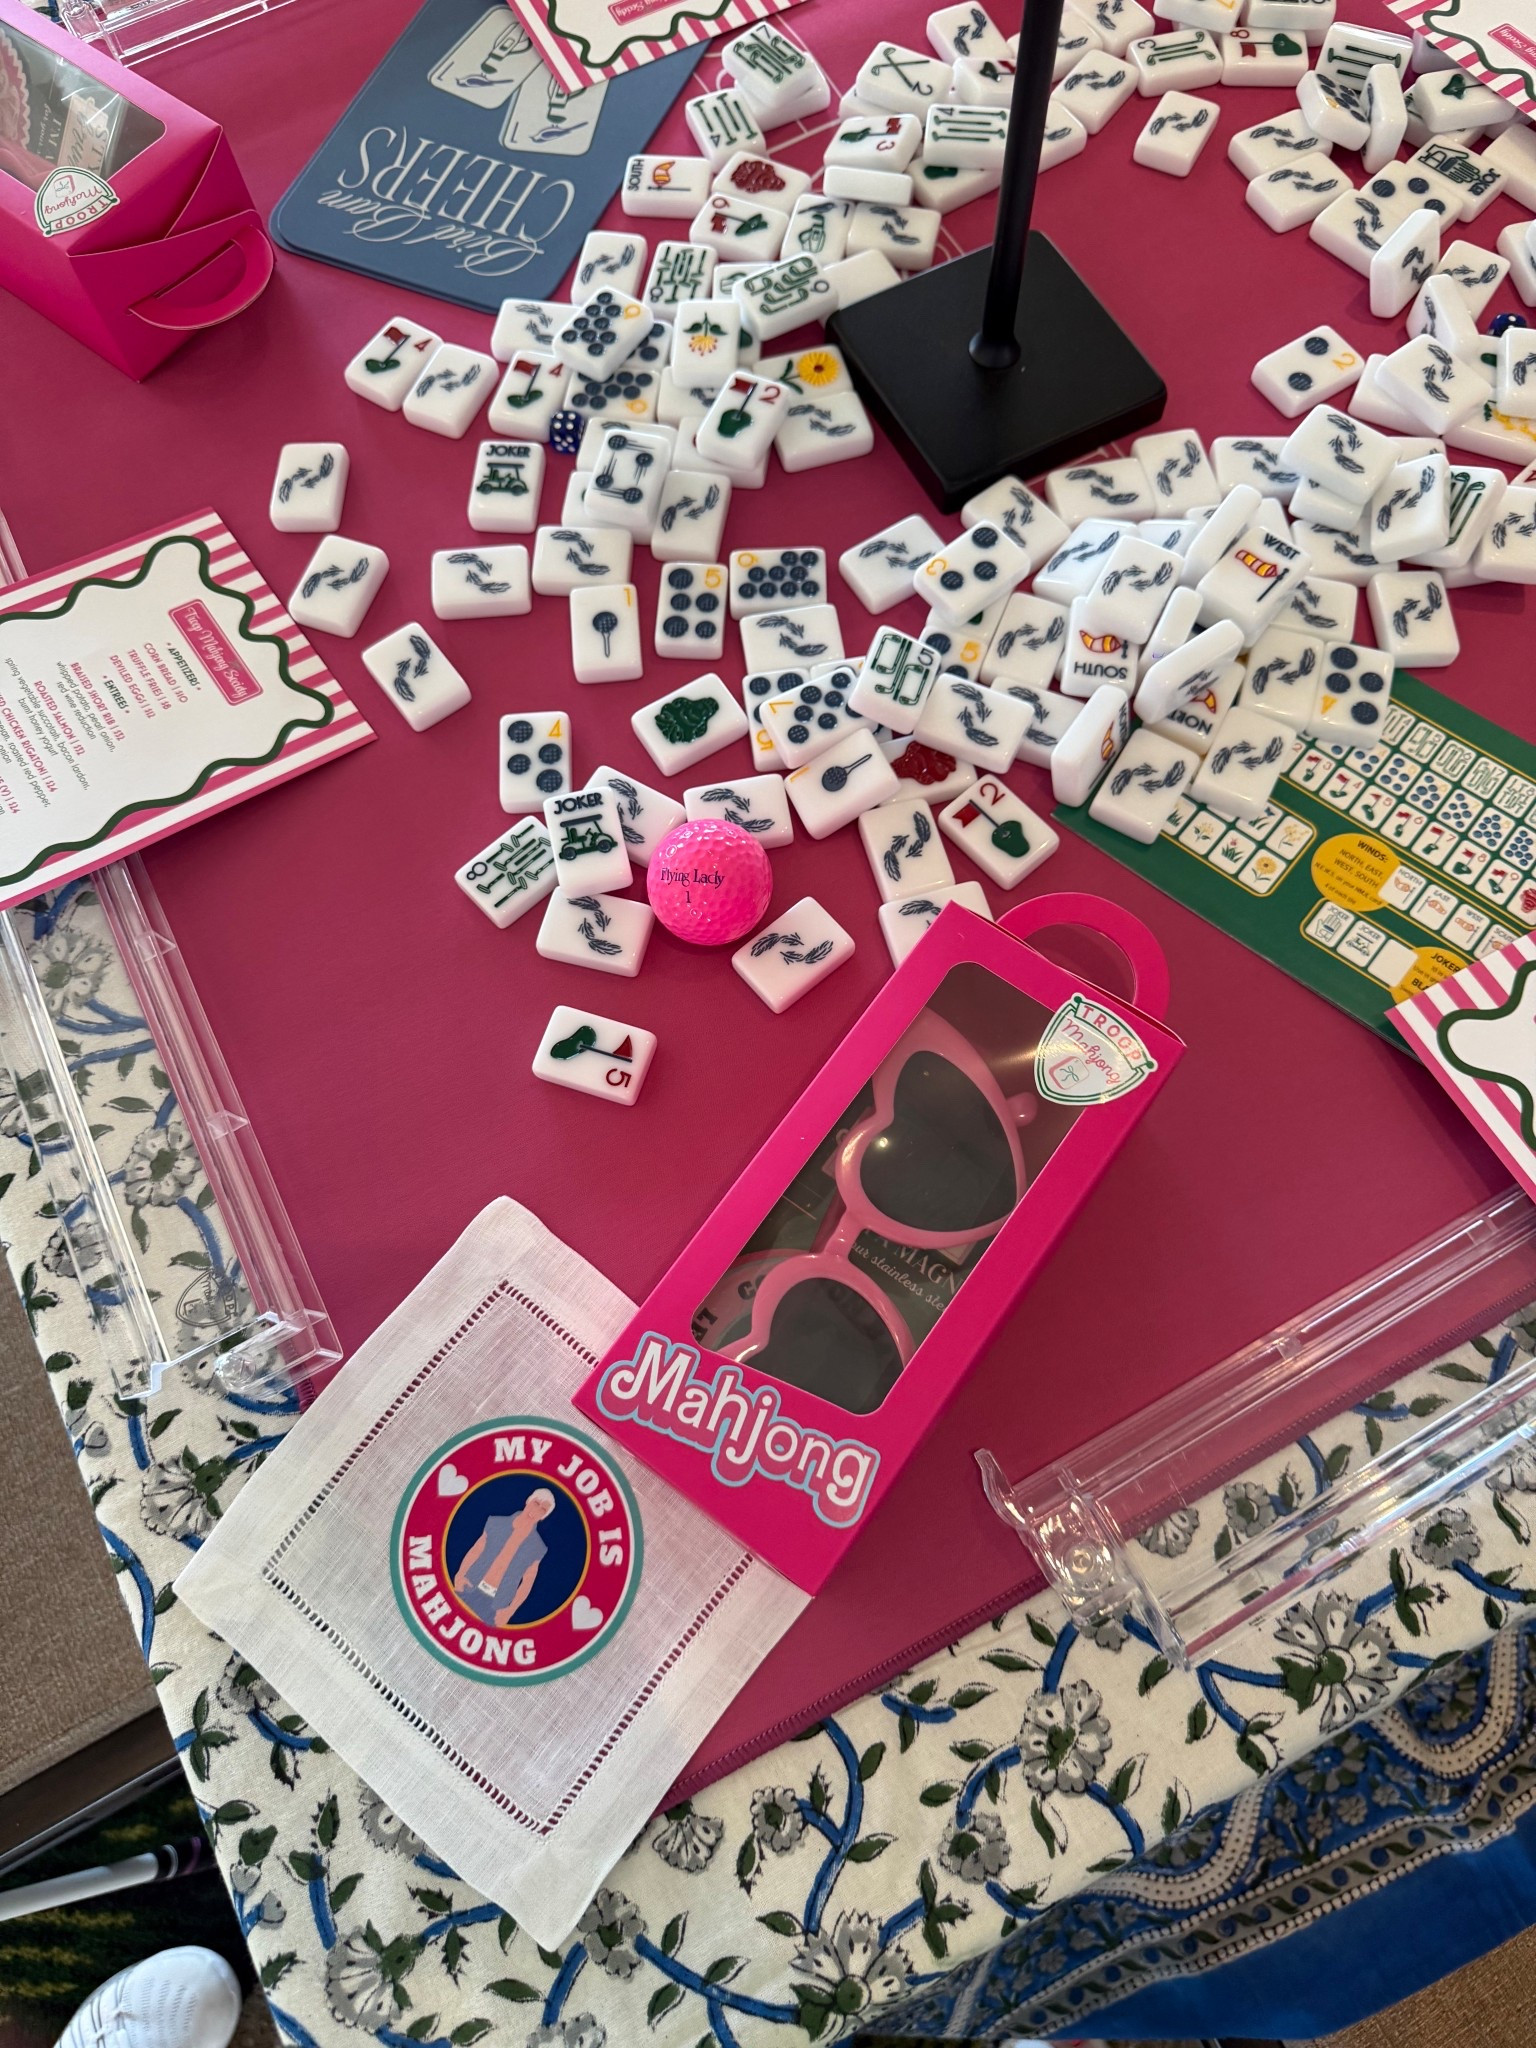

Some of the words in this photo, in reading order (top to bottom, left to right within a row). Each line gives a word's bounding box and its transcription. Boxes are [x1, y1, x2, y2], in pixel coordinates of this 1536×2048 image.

[755, 24, 771, 39] 7
[1230, 29, 1250, 38] 8
[1138, 39, 1156, 50] 3
[912, 82, 933, 96] 2
[937, 108, 955, 116] 4
[710, 134, 720, 148] 4
[876, 140, 896, 151] 3
[338, 126, 574, 241] CHEERS
[628, 159, 644, 192] SOUTH
[1468, 168, 1502, 196] JOKER
[43, 186, 103, 216] Mahjong
[55, 198, 108, 229] TROOP
[414, 338, 434, 352] 4
[549, 362, 565, 378] 4
[1332, 352, 1356, 371] 2
[760, 385, 781, 404] 2
[486, 444, 531, 458] JOKER
[1262, 532, 1300, 562] WEST
[704, 568, 722, 589] 5
[925, 558, 947, 576] 3
[200, 630, 228, 670] Mahjong
[917, 647, 936, 667] 5
[127, 649, 150, 677] TRUFFLE
[146, 677, 162, 696] FRIES
[143, 643, 162, 663] CORN
[157, 663, 176, 685] BREAD
[175, 690, 188, 702] $10
[168, 648, 199, 685] APPETIZERS
[1074, 661, 1128, 680] SOUTH
[109, 655, 132, 682] DEVILED
[128, 683, 146, 703] EGGS
[56, 661, 78, 688] whipped
[86, 712, 105, 730] pearl
[70, 662, 92, 689] BRAISED
[87, 690, 107, 711] SHORT
[102, 712, 115, 725] RIB
[104, 680, 128, 708] ENTREES
[34, 680, 57, 710] ROASTED
[52, 711, 75, 739] SALMON
[56, 681, 69, 693] red
[73, 709, 96, 739] reduction
[768, 700, 794, 714] 7
[17, 676, 40, 708] vegetable
[57, 741, 74, 763] bacon
[548, 718, 562, 738] 4
[1167, 709, 1214, 736] NORT
[1, 707, 26, 739] CHICKEN
[21, 740, 47, 775] RIGATONI
[28, 714, 43, 734] honey
[39, 735, 58, 756] yogurt
[756, 730, 774, 750] 5
[23, 767, 36, 779] red
[553, 792, 604, 815] JOKER
[980, 782, 1006, 806] 2
[1357, 840, 1386, 860] WINDS:
[465, 862, 489, 882] 8
[660, 866, 691, 888] Flying
[692, 868, 726, 889] Lady
[1354, 871, 1378, 887] SOUTH
[1398, 869, 1422, 885] NORTH
[1328, 905, 1350, 920] JOKER
[1359, 924, 1380, 940] JOKER
[1084, 1006, 1142, 1060] TROOP
[1062, 1018, 1120, 1085] Mahjong
[606, 1068, 632, 1089] 5
[870, 1256, 923, 1297] stainless
[925, 1292, 946, 1312] ste
[606, 1338, 874, 1511] Mahjong
[493, 1435, 552, 1463] MY
[556, 1454, 614, 1518] JOB
[598, 1526, 623, 1566] IS
[408, 1534, 536, 1666] MAHJONG
